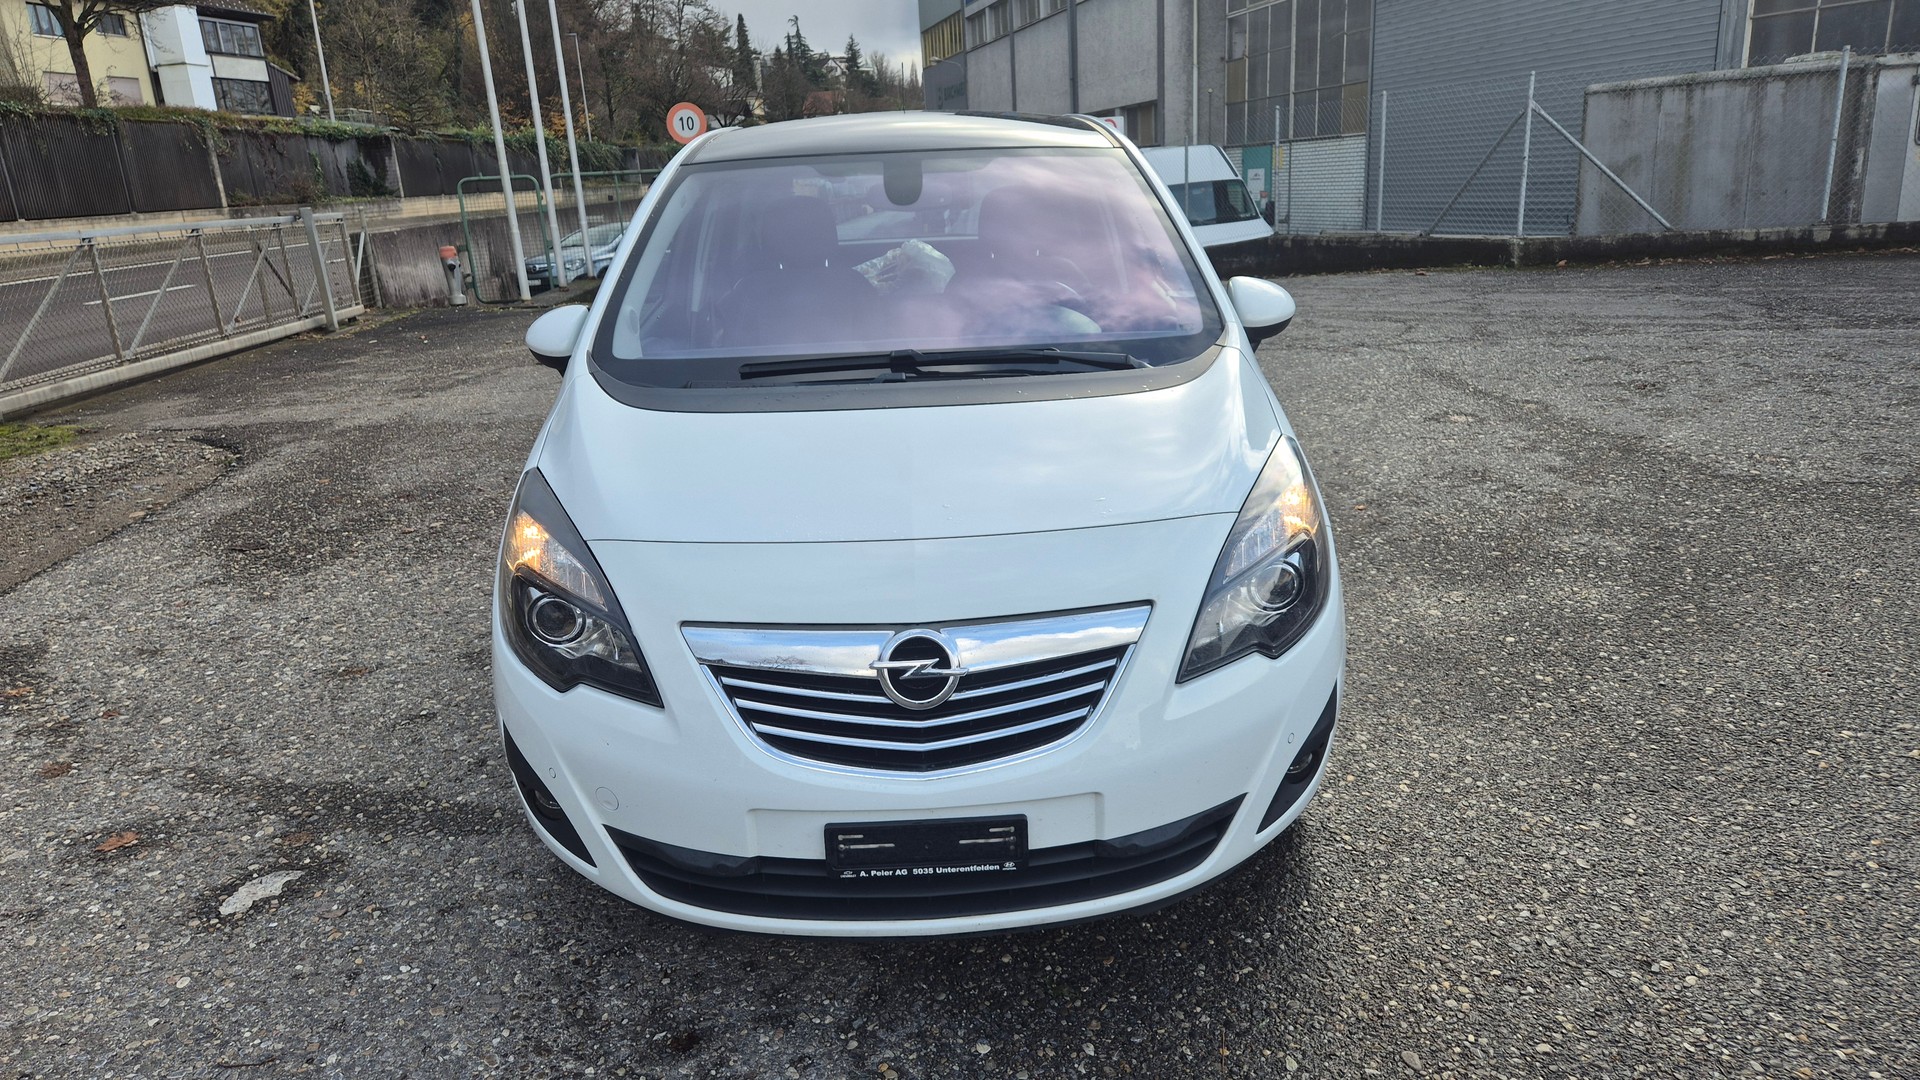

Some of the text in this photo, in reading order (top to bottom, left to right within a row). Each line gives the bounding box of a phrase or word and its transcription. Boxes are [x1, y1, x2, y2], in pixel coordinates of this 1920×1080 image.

[679, 116, 694, 131] 10
[895, 868, 908, 876] AG
[912, 867, 934, 875] 5035
[936, 864, 1000, 874] Unterentfelden
